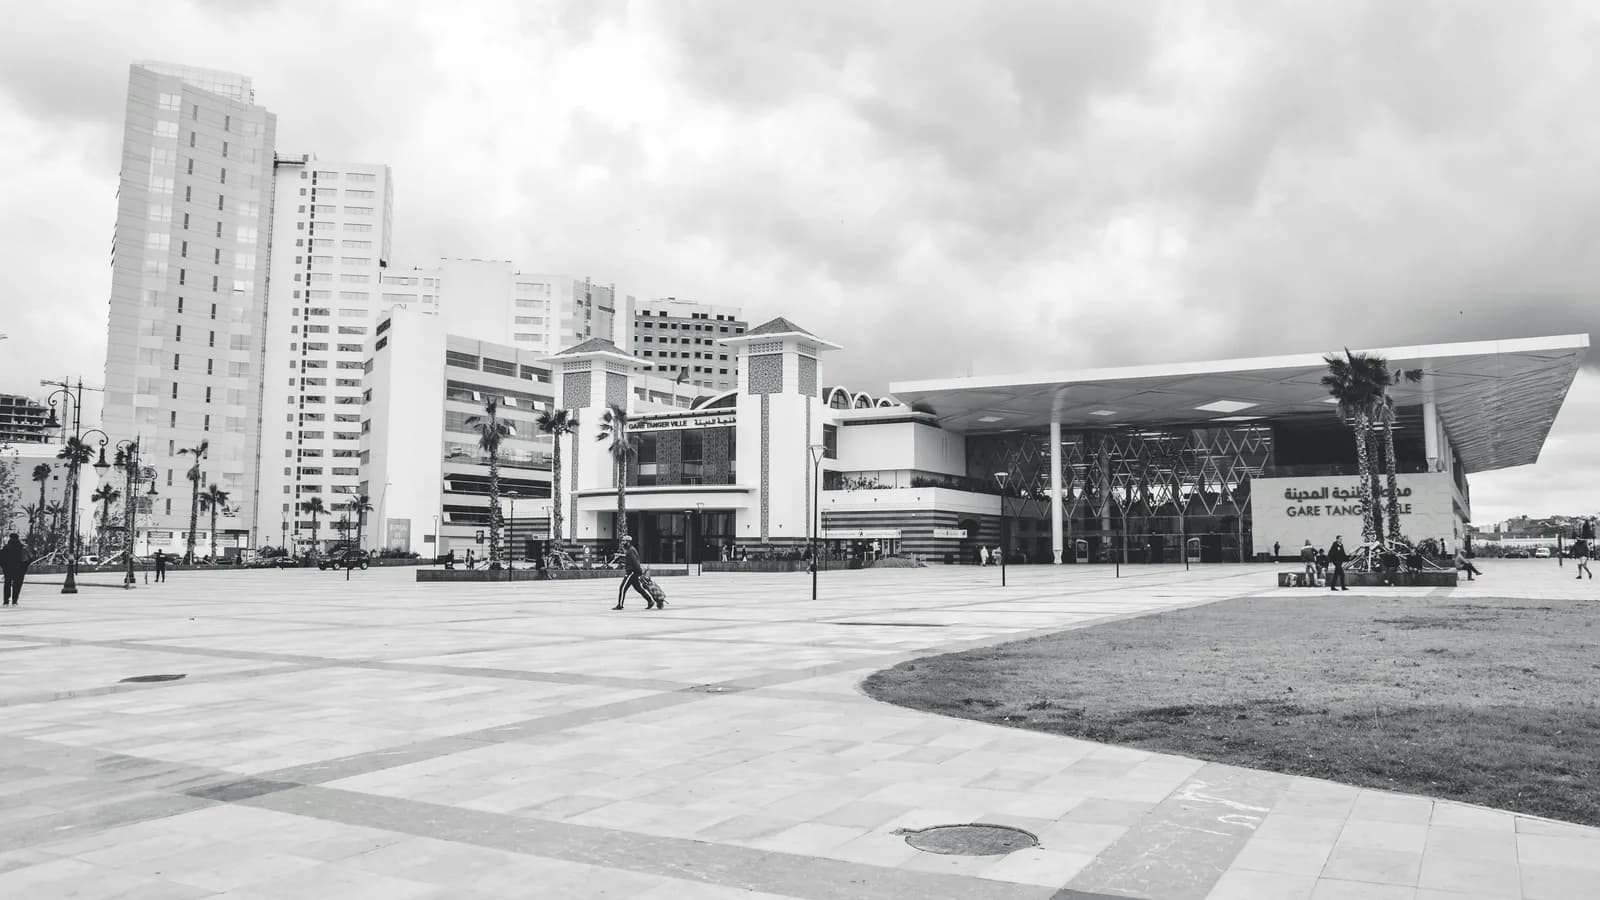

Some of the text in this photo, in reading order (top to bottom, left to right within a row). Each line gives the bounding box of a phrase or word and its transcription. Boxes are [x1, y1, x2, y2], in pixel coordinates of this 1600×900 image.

[628, 421, 646, 430] GARE
[646, 421, 670, 429] TANGER
[1284, 486, 1329, 503] المدينة
[1378, 484, 1412, 498] محط
[1286, 503, 1412, 517] GARE TANG VLE
